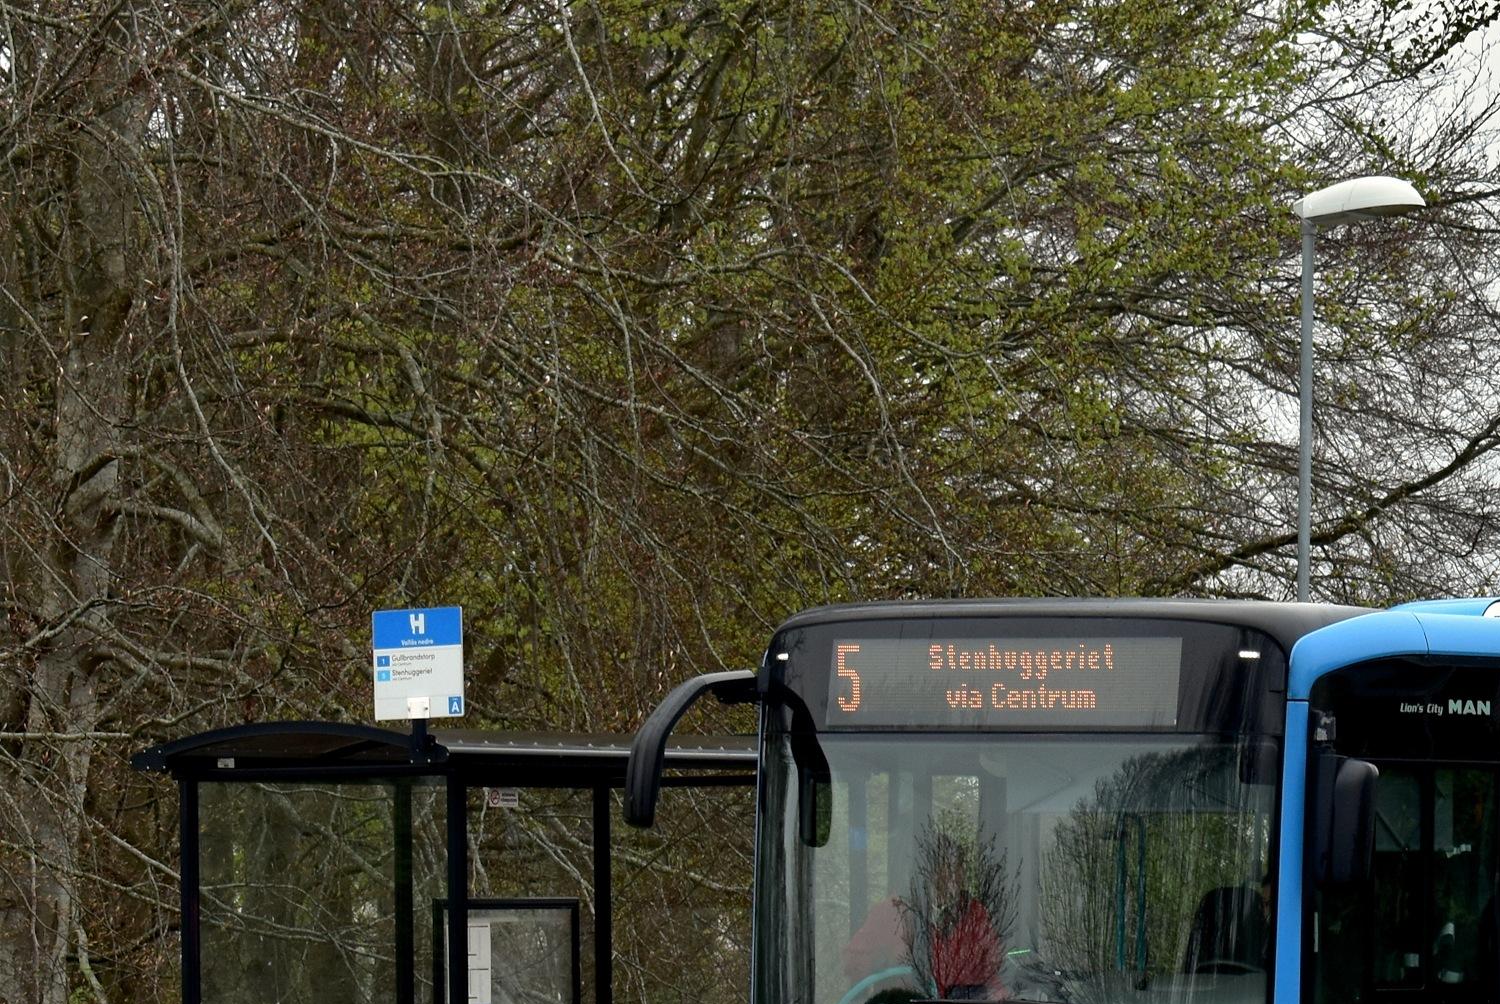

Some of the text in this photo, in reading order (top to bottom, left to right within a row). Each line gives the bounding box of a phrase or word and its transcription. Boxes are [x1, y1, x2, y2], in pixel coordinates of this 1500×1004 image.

[409, 613, 425, 635] H
[928, 643, 1114, 680] Stenhuggeriet
[836, 644, 861, 712] 5
[451, 700, 460, 713] A
[945, 682, 1097, 709] via Centrum
[1400, 699, 1491, 716] Lion's City MAN
